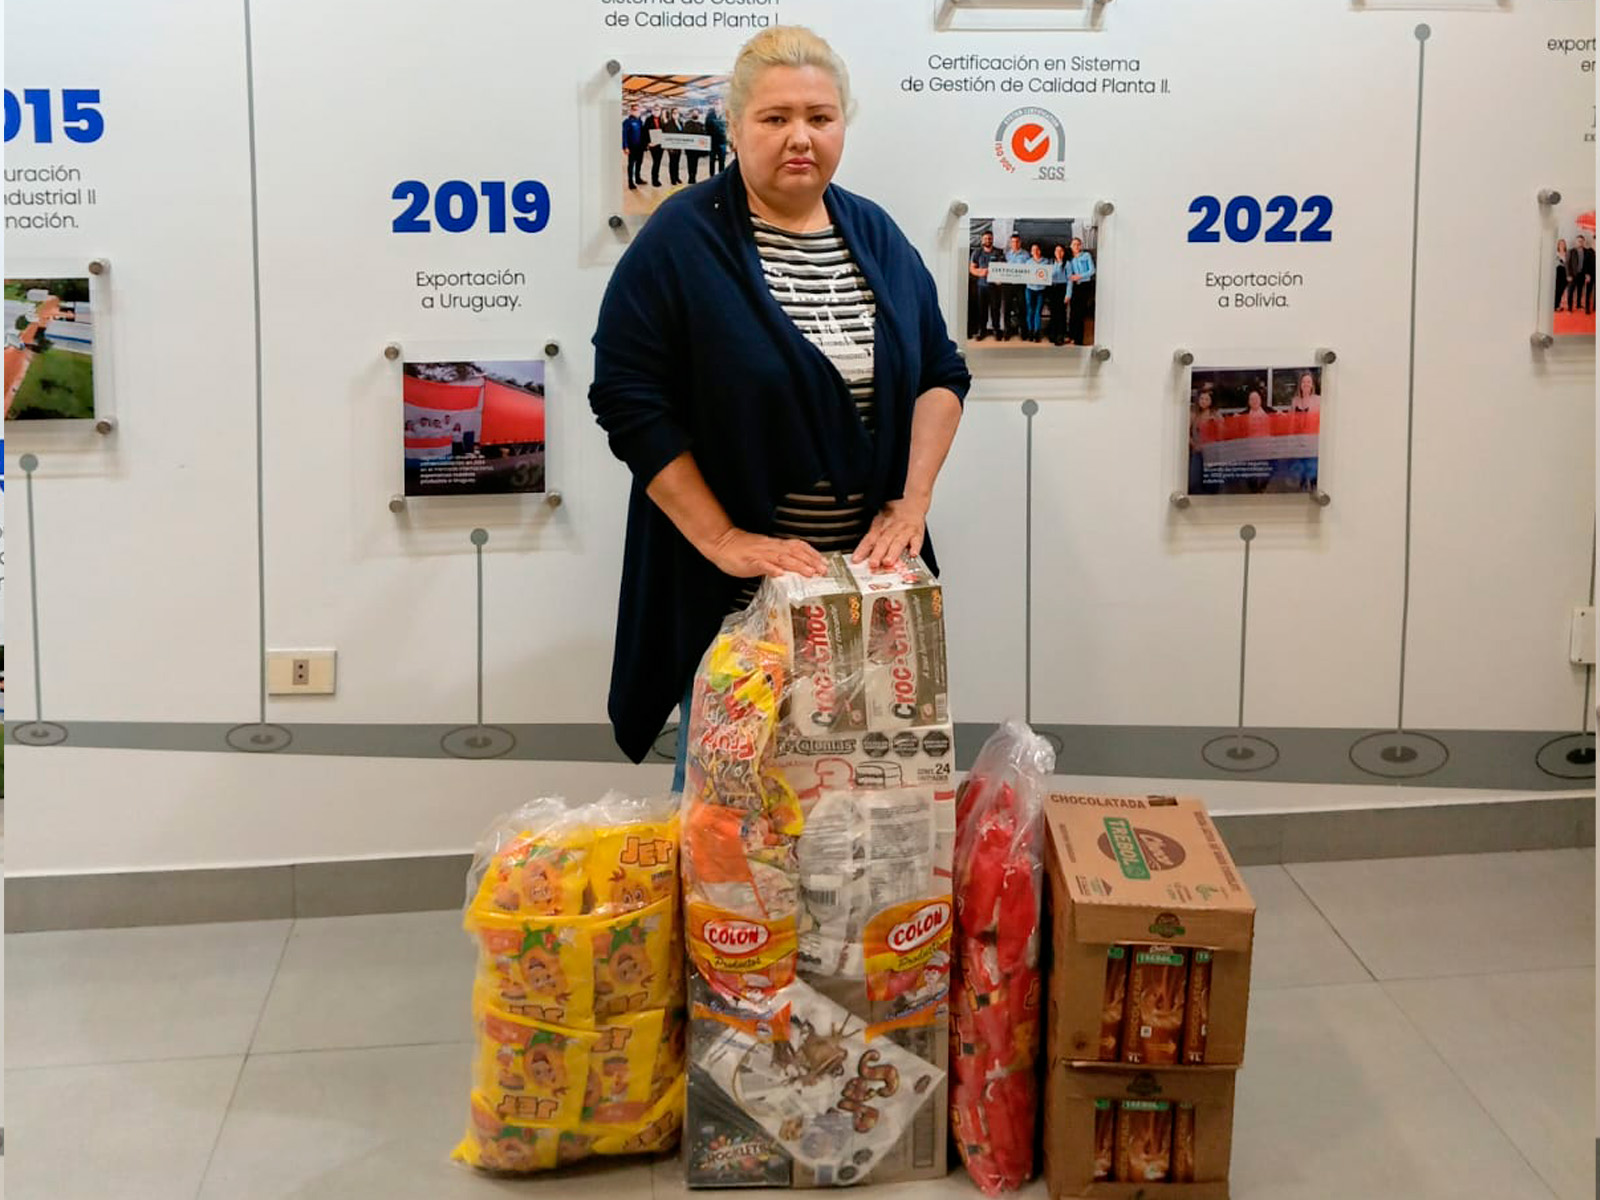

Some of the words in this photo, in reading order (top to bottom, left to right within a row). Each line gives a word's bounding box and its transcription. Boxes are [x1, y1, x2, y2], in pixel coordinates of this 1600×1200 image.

[604, 10, 631, 28] de
[635, 11, 708, 28] Calidad
[713, 12, 770, 29] Planta
[928, 54, 1040, 72] Certificación
[1044, 59, 1067, 72] en
[1071, 56, 1141, 72] Sistema
[900, 75, 925, 93] de
[929, 75, 996, 93] Gestión
[1000, 77, 1025, 93] de
[1028, 77, 1098, 94] Calidad
[1102, 78, 1157, 94] Planta
[1038, 166, 1065, 180] SGS
[88, 189, 97, 206] II
[392, 180, 551, 234] 2019
[1187, 195, 1334, 243] 2022
[416, 268, 527, 290] Exportación
[1205, 271, 1304, 291] Exportación
[421, 296, 435, 309] a
[440, 293, 523, 313] Uruguay.
[1218, 296, 1230, 308] a
[1235, 292, 1291, 309] Bolivia.
[935, 763, 951, 774] 24
[1050, 794, 1147, 809] CHOCOLATADA
[620, 836, 674, 867] JET
[1108, 819, 1137, 867] TREBOL
[894, 906, 943, 946] COLON
